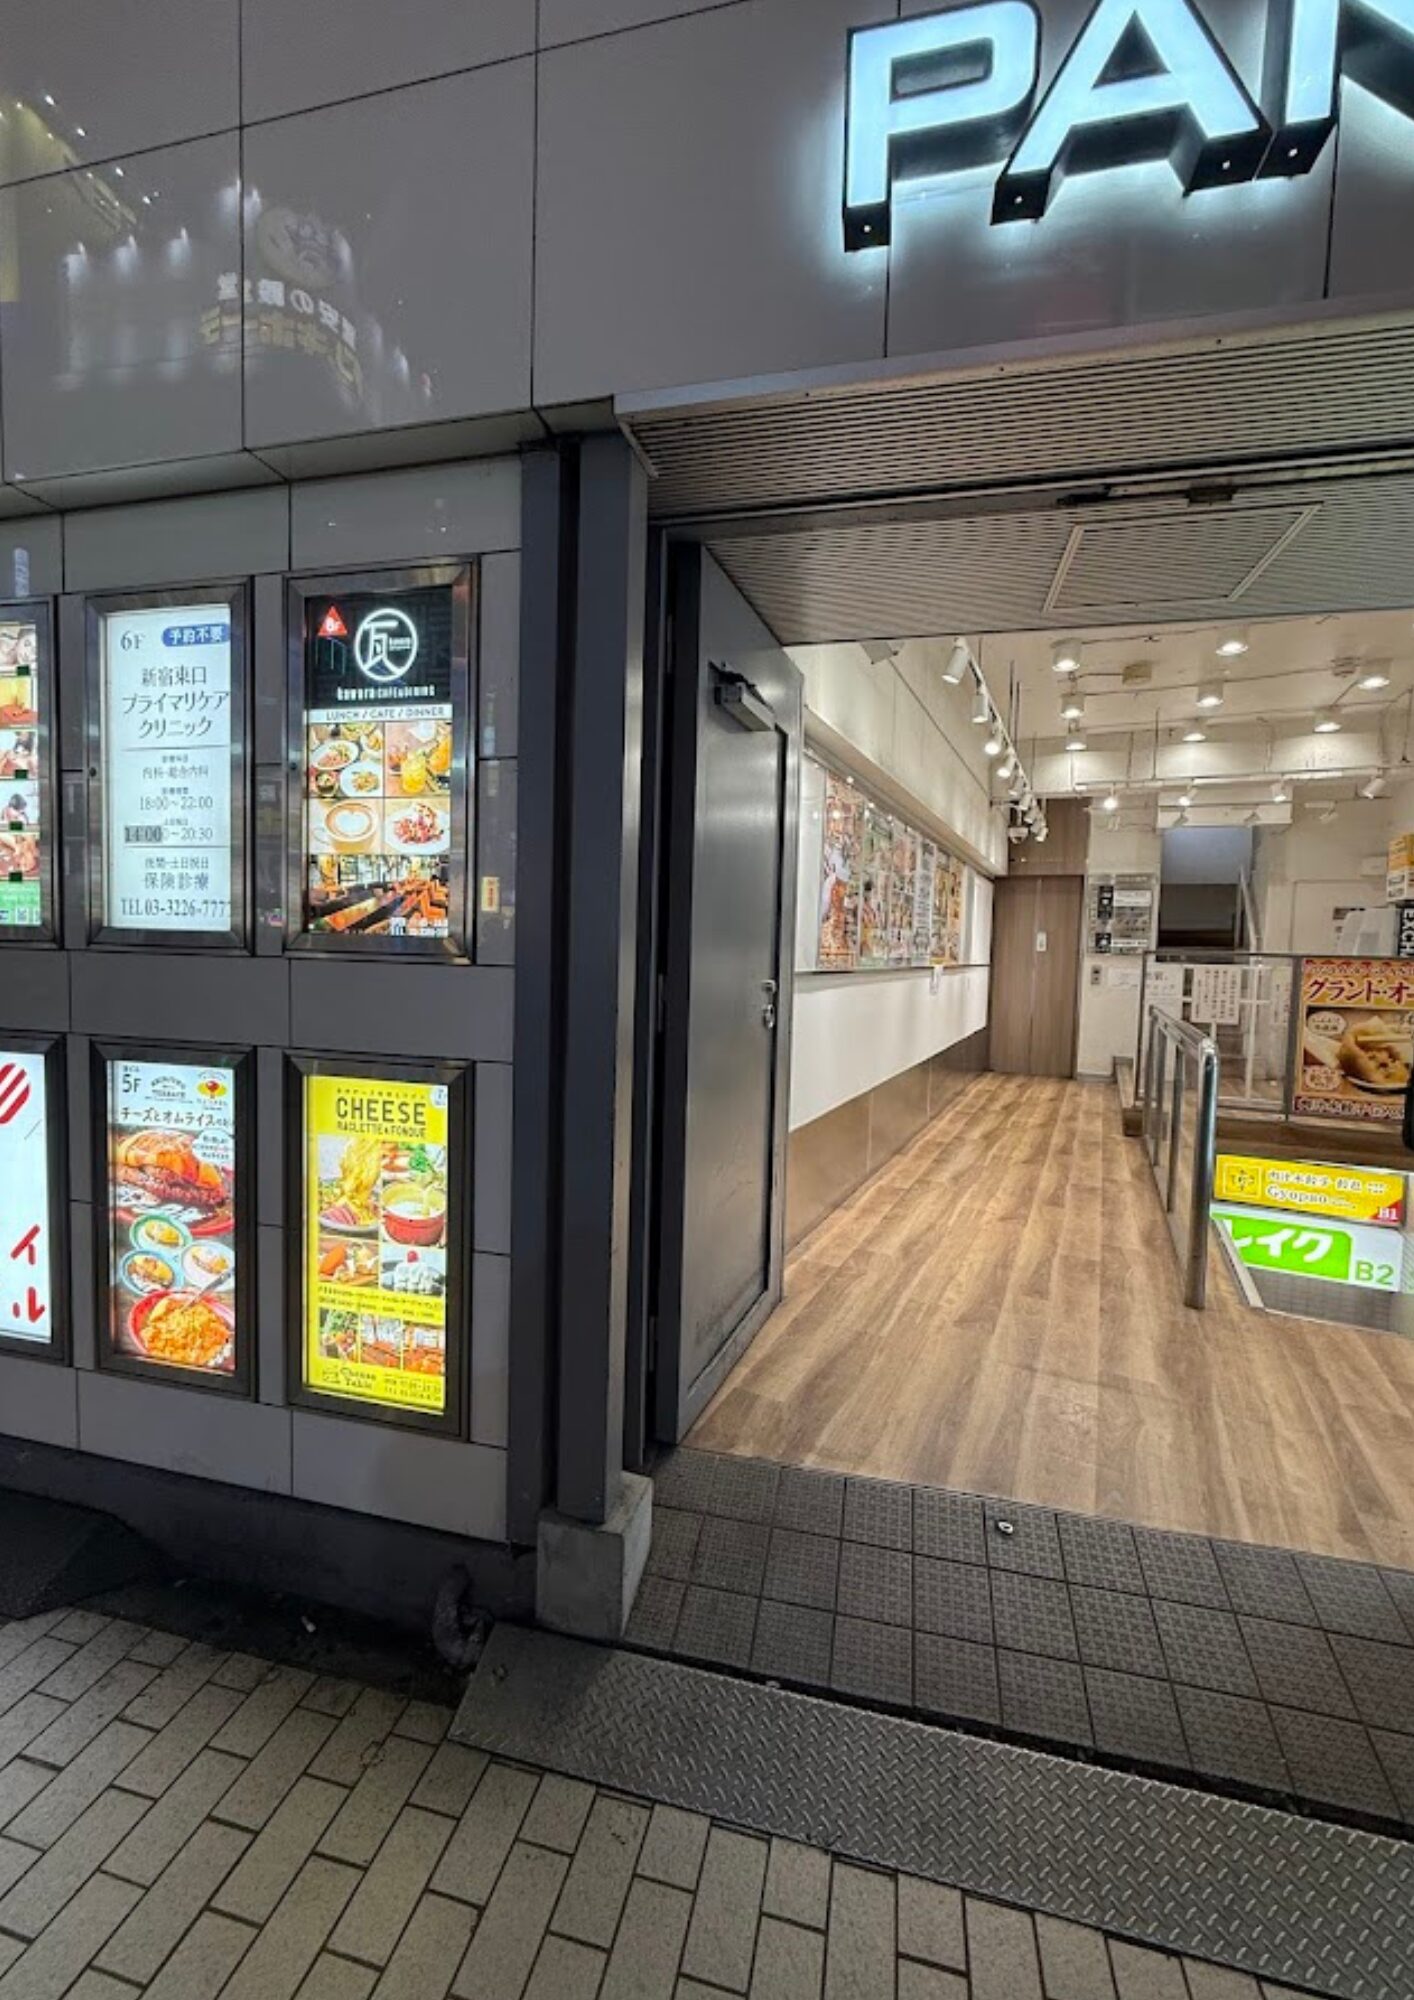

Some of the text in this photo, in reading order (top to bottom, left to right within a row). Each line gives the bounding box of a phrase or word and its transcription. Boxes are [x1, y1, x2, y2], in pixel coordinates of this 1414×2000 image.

[120, 631, 145, 651] 6F
[143, 665, 206, 686] 新宿東口
[139, 716, 212, 738] クリニック
[144, 872, 209, 890] 保険診療
[122, 1074, 141, 1093] 5F
[336, 1097, 426, 1126] CHEESE
[1377, 1208, 1399, 1220] B1
[1355, 1260, 1394, 1285] B2
